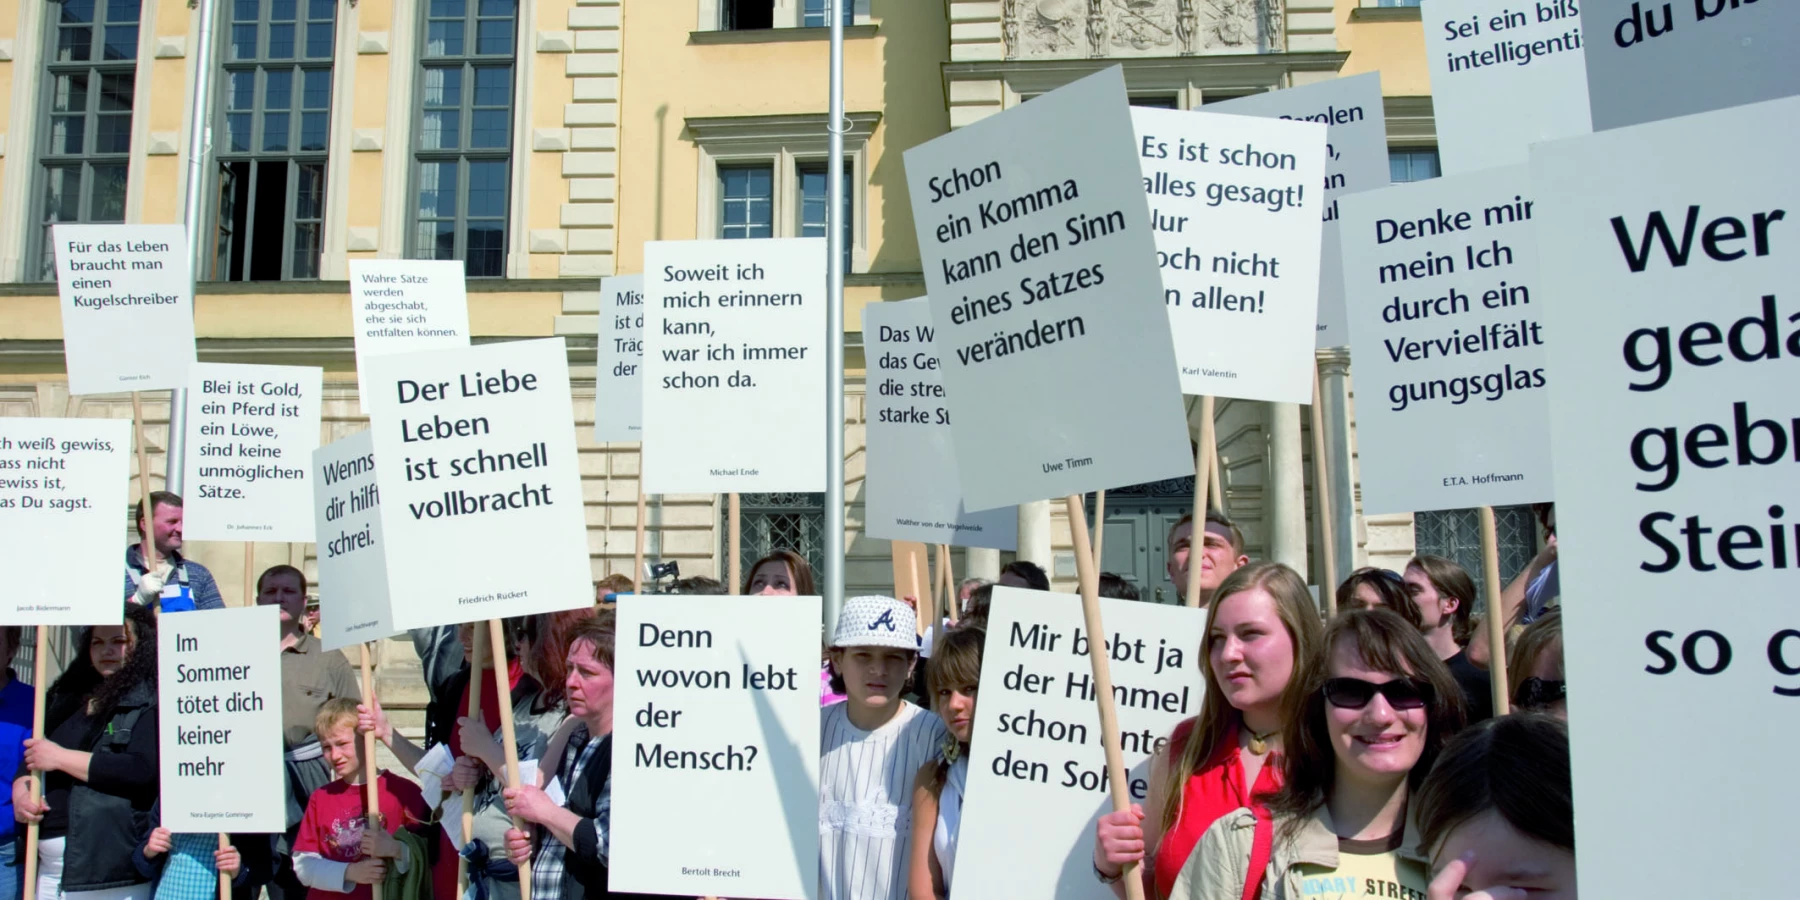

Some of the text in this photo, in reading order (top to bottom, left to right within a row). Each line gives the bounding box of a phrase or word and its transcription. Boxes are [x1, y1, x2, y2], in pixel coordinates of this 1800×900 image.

[1444, 20, 1480, 41] Sei
[1489, 9, 1526, 31] ein
[1614, 2, 1673, 48] du
[1447, 28, 1584, 73] intelligenti
[1142, 136, 1295, 170] Es ist schon
[928, 159, 1002, 203] Schon
[1143, 170, 1303, 212] alles gesagt!
[937, 177, 1080, 243] ein Komma
[1376, 196, 1533, 244] Denke mir
[68, 239, 170, 254] Für das Leben
[942, 211, 1125, 285] kann den Sinn
[1610, 205, 1786, 272] Wer
[69, 258, 163, 272] braucht man
[1213, 252, 1279, 278] nicht
[1380, 240, 1512, 283] mein Ich
[71, 276, 112, 290] einen
[361, 273, 398, 284] Wahre
[663, 262, 765, 283] Soweit ich
[73, 292, 179, 311] Kugelschreiber
[362, 286, 404, 297] werden
[663, 289, 803, 309] mich erinnern
[951, 264, 1104, 325] eines Satzes
[1192, 286, 1264, 313] allen!
[1383, 281, 1529, 323] durch ein
[364, 300, 428, 313] abgeschabt,
[365, 313, 427, 324] ehe sie sich
[614, 314, 631, 330] ist
[662, 317, 716, 338] kann,
[366, 327, 414, 338] entfalten
[879, 325, 911, 343] Das
[956, 315, 1086, 367] verändern
[1384, 320, 1544, 362] Vervielfält
[661, 342, 809, 362] war ich immer
[878, 351, 941, 371] das Ge
[612, 360, 638, 377] der
[1181, 366, 1238, 379] Karl Valentin
[202, 379, 303, 399] Blei ist Gold,
[398, 369, 537, 404] Der Liebe
[662, 369, 757, 390] schon da.
[878, 377, 905, 397] die
[1389, 364, 1546, 411] gungsglas
[201, 400, 300, 418] ein Pferd ist
[878, 405, 930, 425] starke
[200, 421, 279, 440] ein Löwe,
[402, 415, 489, 442] Leben
[17, 436, 115, 455] weiß gewiss,
[199, 442, 282, 459] sind keine
[26, 456, 66, 470] nicht
[323, 454, 374, 487] Wenns
[405, 442, 547, 481] ist schnell
[709, 467, 760, 477] Michael Ende
[1042, 457, 1094, 474] Uwe Timm
[43, 475, 66, 492] ist,
[198, 464, 304, 483] unmöglichen
[1442, 472, 1524, 487] E.T.A. Hoffmann
[198, 484, 246, 499] Sätze.
[409, 483, 553, 519] vollbracht
[21, 495, 44, 509] Du
[49, 496, 92, 513] sagst.
[326, 497, 345, 521] dir
[895, 518, 921, 527] Walther
[933, 521, 946, 529] der
[328, 523, 374, 558] schrei.
[1639, 505, 1800, 573] Stei
[457, 593, 495, 605] Friedrich
[176, 633, 198, 653] Im
[639, 623, 712, 648] Denn
[1010, 622, 1062, 652] Mir
[1154, 639, 1183, 674] ja
[1645, 630, 1732, 675] so
[176, 663, 251, 684] Sommer
[636, 663, 797, 692] wovon lebt
[1004, 664, 1055, 694] der
[176, 690, 264, 715] tötet dich
[636, 702, 682, 728] der
[177, 724, 232, 746] keiner
[997, 709, 1086, 744] schon
[178, 755, 226, 777] mehr
[636, 743, 757, 771] Mensch?
[992, 750, 1048, 783] den
[681, 866, 741, 878] Bertolt Brecht
